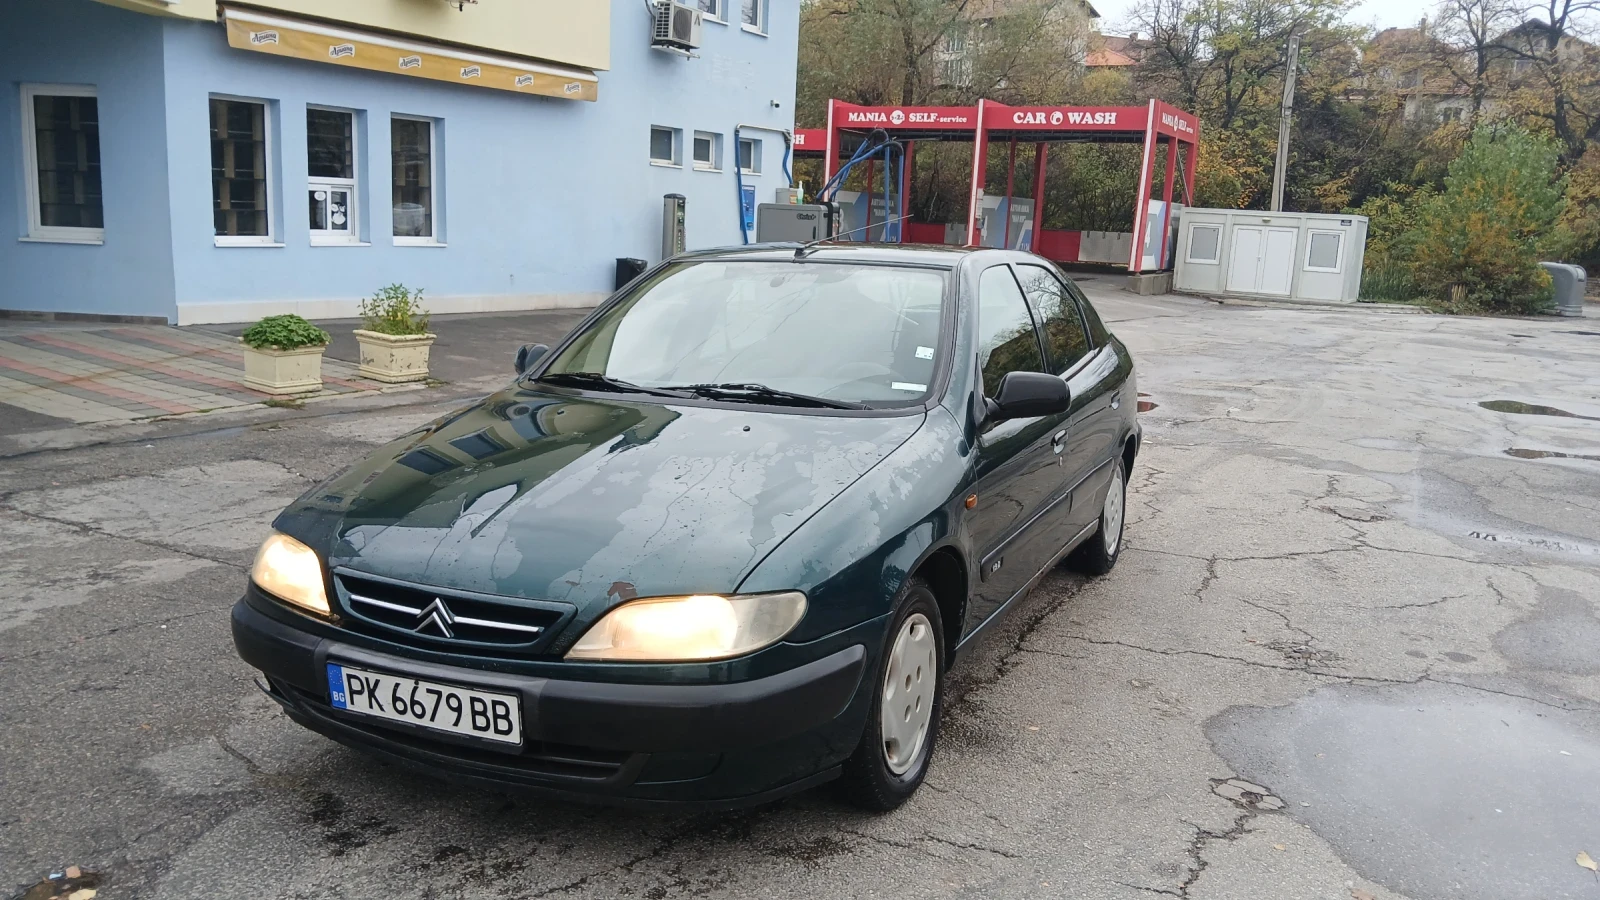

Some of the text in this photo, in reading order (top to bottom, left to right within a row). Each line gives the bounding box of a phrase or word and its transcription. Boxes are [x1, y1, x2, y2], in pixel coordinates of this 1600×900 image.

[848, 112, 887, 122] MANIA
[909, 112, 967, 123] SELF-service
[1013, 112, 1117, 125] CAR WASH
[333, 690, 345, 703] BG
[346, 673, 514, 736] PK 6679 BB
